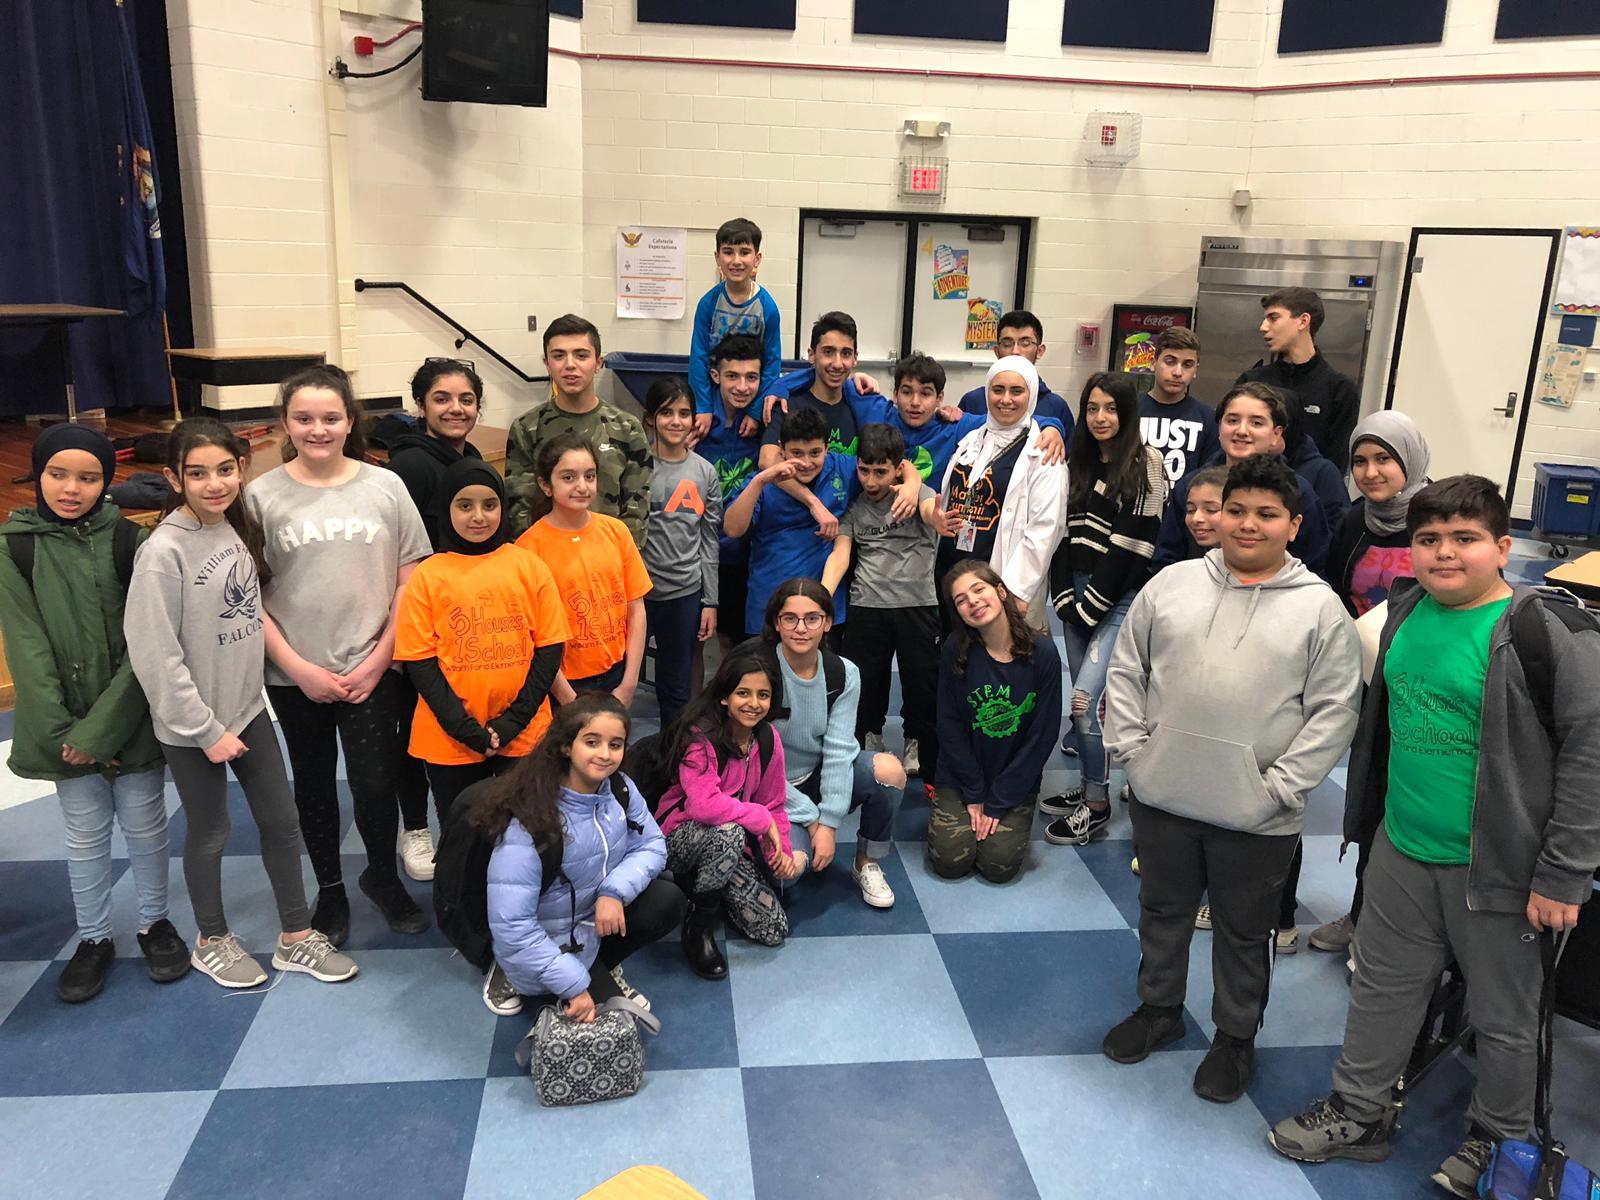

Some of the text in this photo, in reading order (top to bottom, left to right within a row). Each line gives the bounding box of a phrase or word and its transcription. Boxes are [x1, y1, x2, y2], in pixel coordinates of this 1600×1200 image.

[912, 169, 940, 192] EXIT
[937, 274, 969, 296] ADVENTURE
[967, 321, 999, 340] MYSTER
[1140, 417, 1203, 452] JUST
[1157, 449, 1186, 481] O
[277, 518, 382, 552] HAPPY
[194, 547, 235, 586] William
[568, 591, 590, 617] 5
[448, 607, 524, 636] 5 Houses
[465, 635, 527, 662] School
